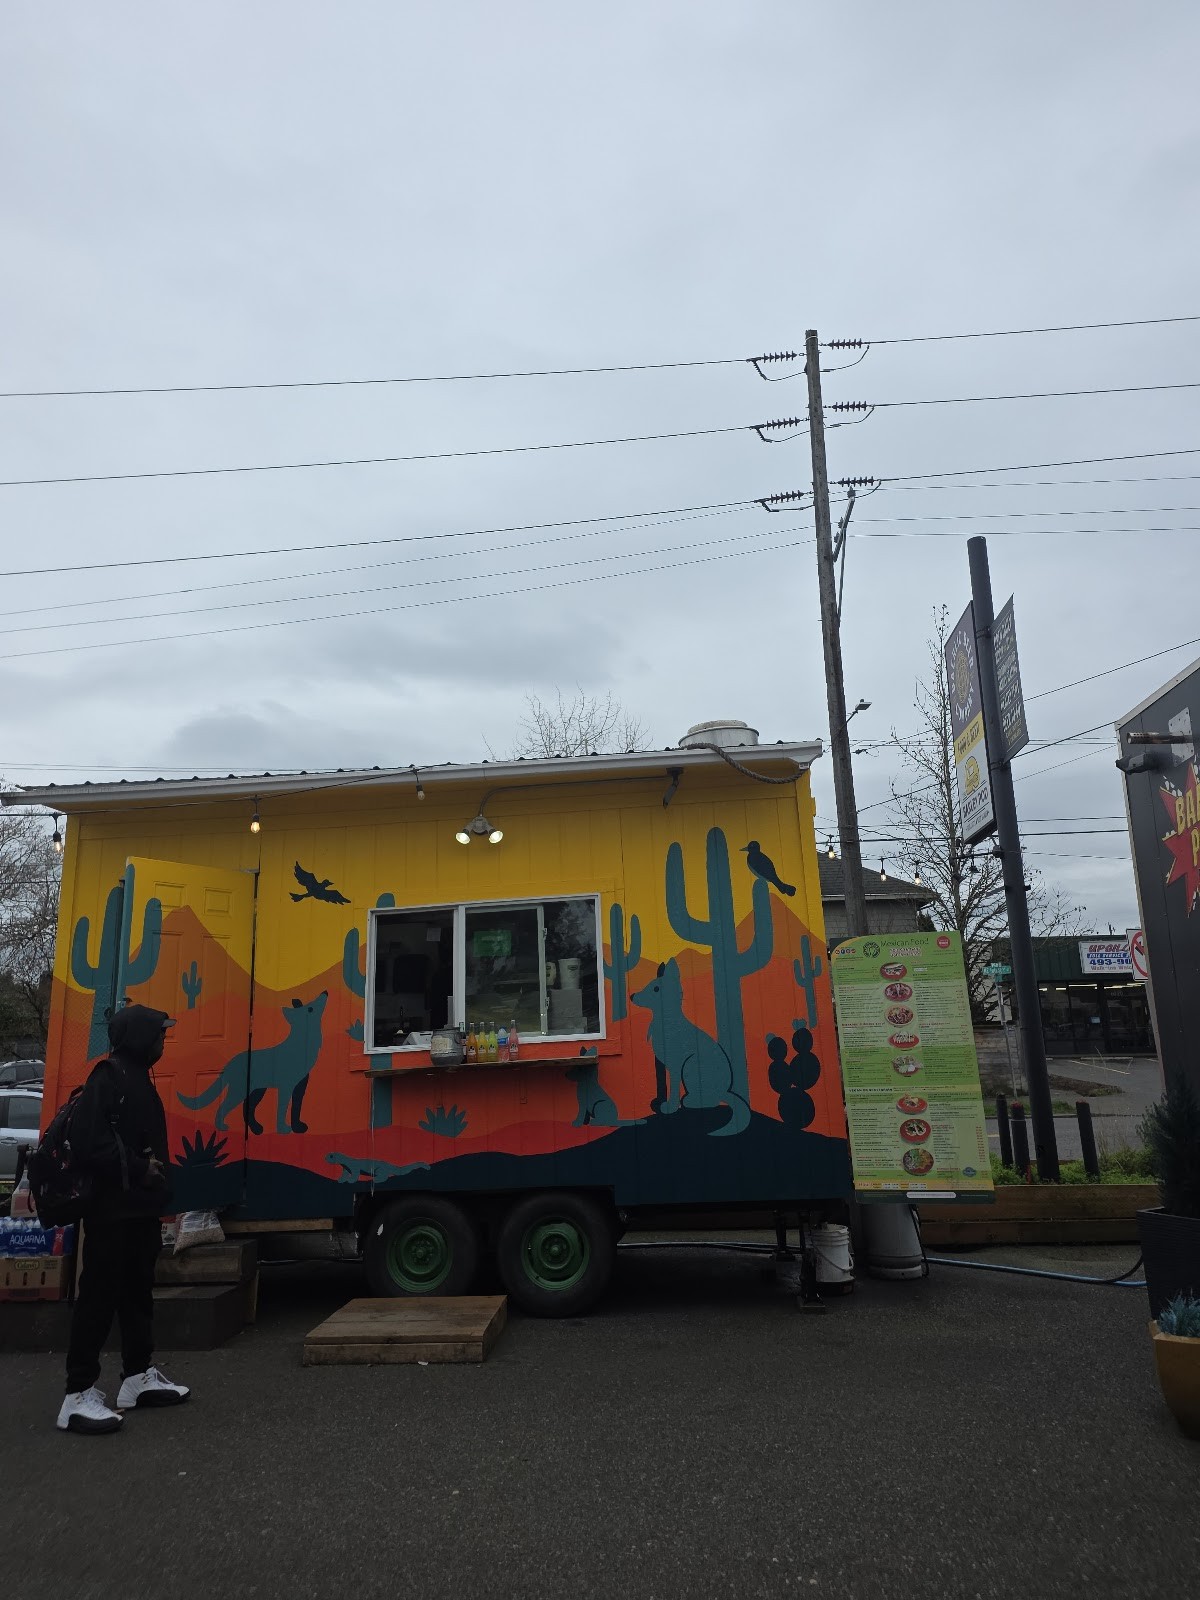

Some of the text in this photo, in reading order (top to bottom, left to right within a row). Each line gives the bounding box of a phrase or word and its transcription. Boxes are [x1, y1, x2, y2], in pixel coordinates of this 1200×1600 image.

[880, 939, 910, 947] Mexican
[910, 937, 929, 946] Food
[9, 1234, 46, 1245] AQUAFINA
